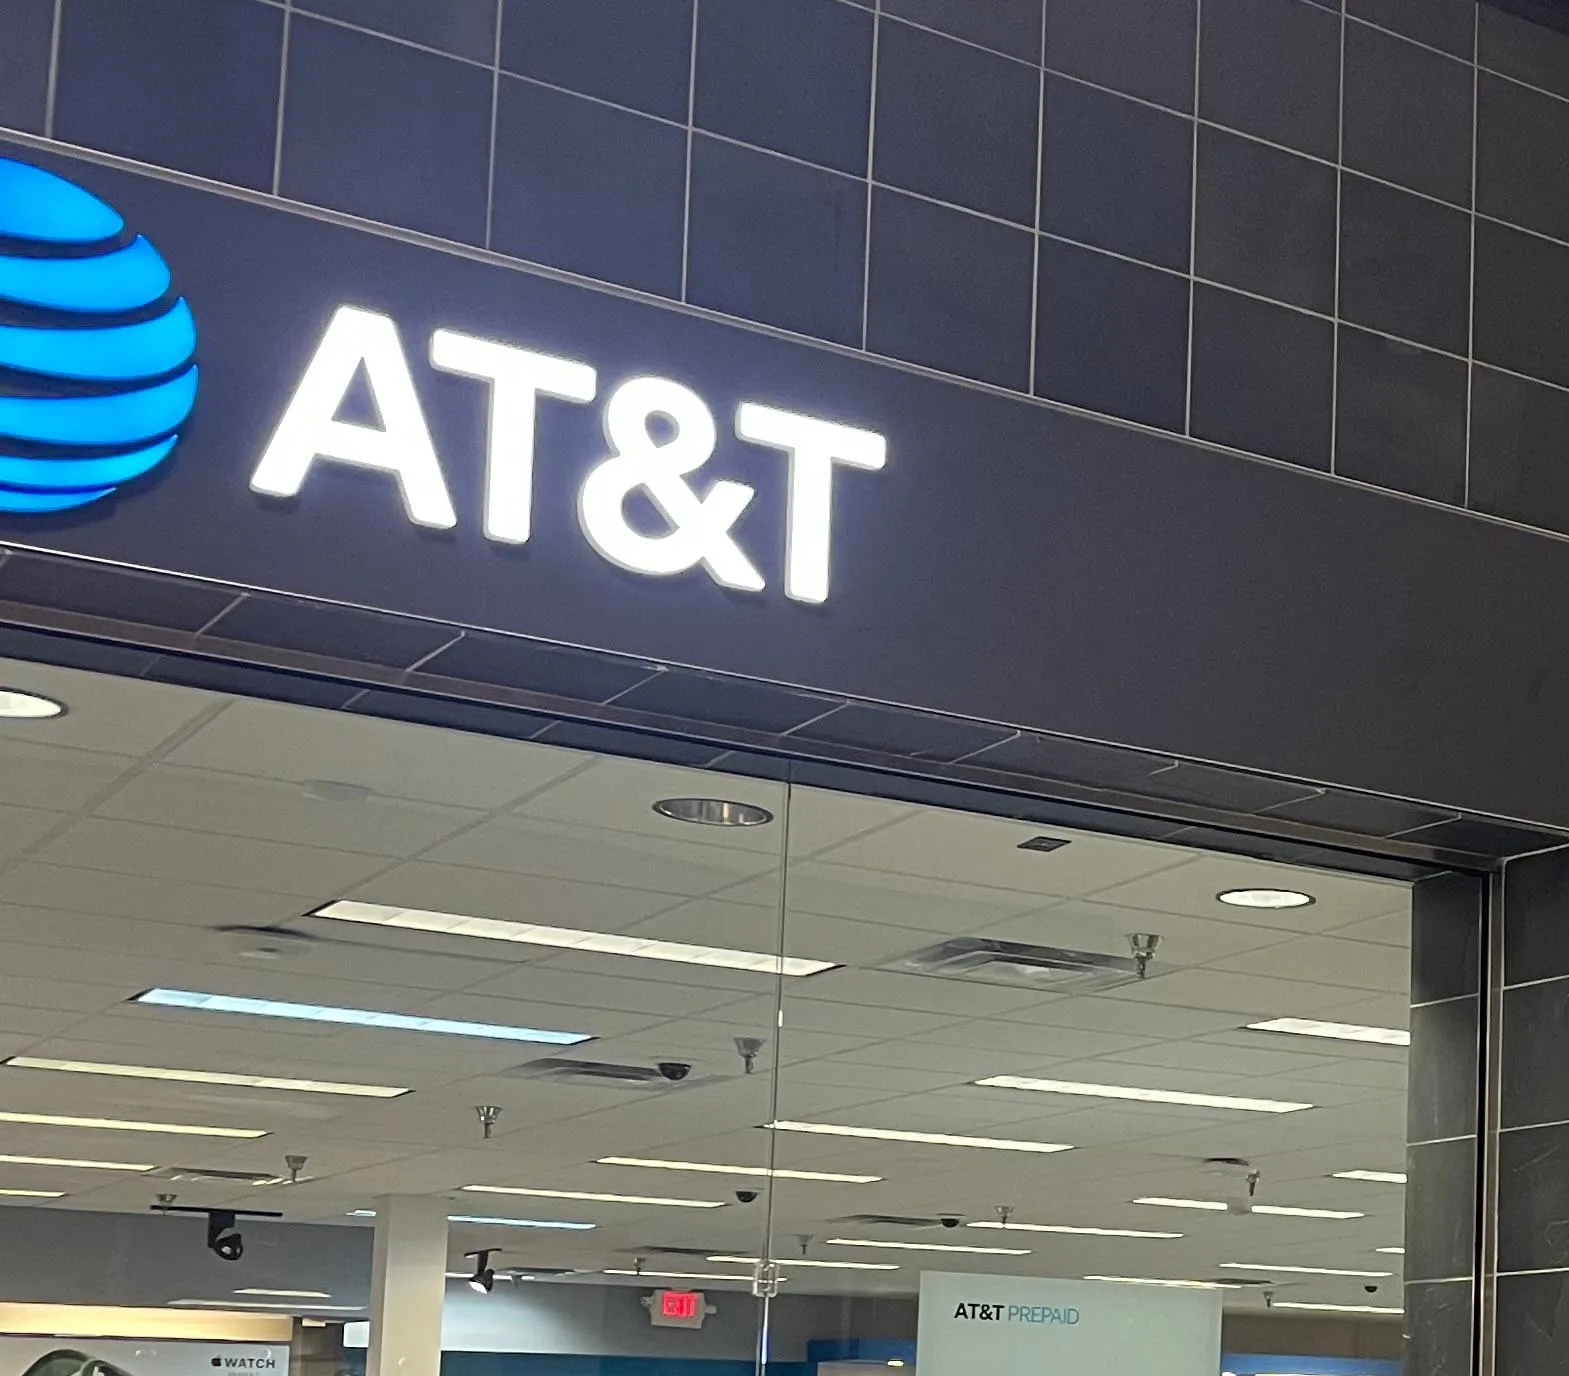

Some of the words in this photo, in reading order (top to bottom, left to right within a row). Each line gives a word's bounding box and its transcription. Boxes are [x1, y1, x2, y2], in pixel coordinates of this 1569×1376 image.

[249, 304, 887, 603] AT&T
[954, 1303, 1004, 1321] AT&T
[1008, 1305, 1080, 1325] PREPAID
[224, 1358, 276, 1369] WATCH
